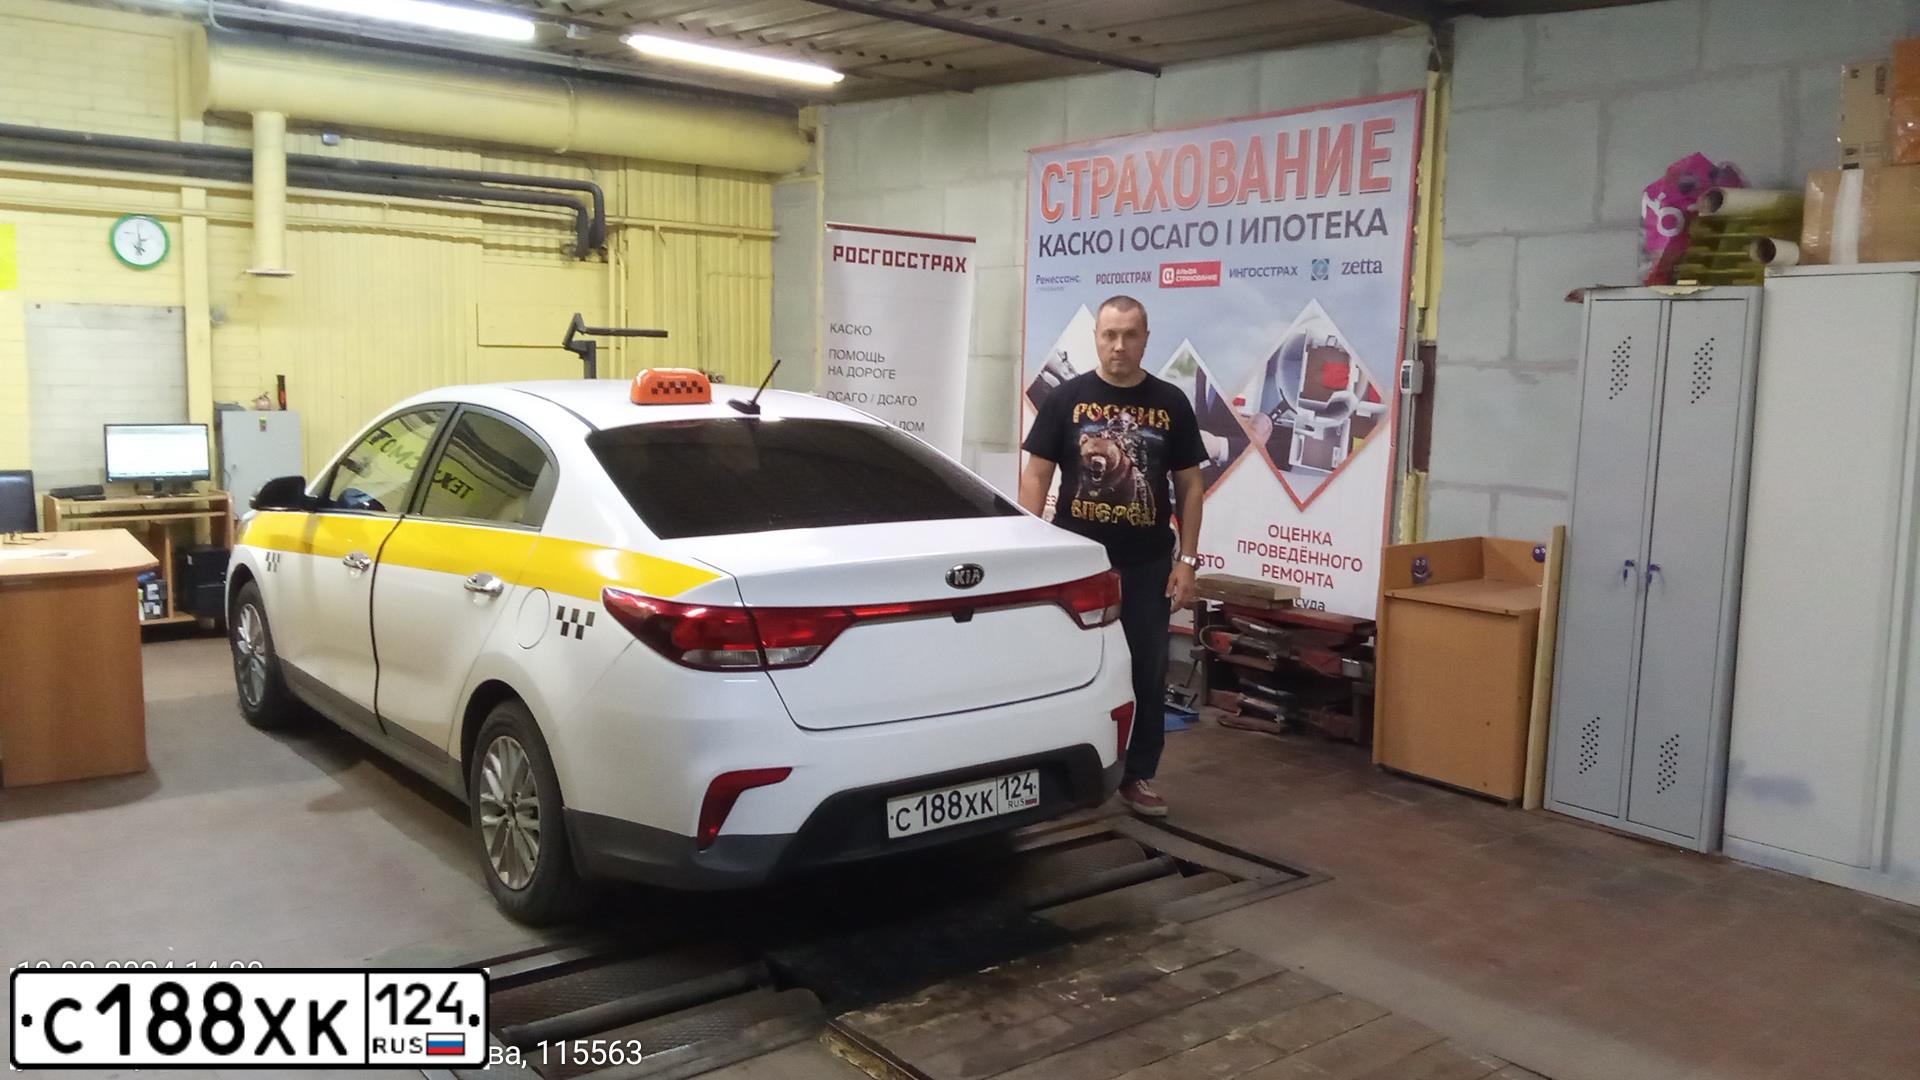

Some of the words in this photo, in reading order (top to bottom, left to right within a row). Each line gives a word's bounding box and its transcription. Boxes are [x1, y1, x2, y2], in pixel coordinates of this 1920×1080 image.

[1040, 117, 1394, 222] СТРАХОВАНИЕ
[1038, 231, 1113, 258] КАСКО
[1130, 221, 1219, 252] ОСАГО
[1240, 208, 1389, 245] ИПОТЕКА
[832, 245, 968, 273] РОСГОССТРАХ
[1341, 258, 1383, 275] zetta
[1095, 271, 1152, 285] РОСГОССТРАХ
[1229, 265, 1298, 279] ИНГОССТРАХ
[829, 322, 872, 336] КАСКО
[829, 348, 885, 363] ПОМОЩЬ
[828, 366, 844, 377] НА
[846, 367, 896, 380] ДОРОГЕ
[826, 391, 868, 403] ОСАГО
[877, 394, 918, 407] ДСАГО
[900, 421, 925, 432] ДОМ
[1267, 524, 1333, 547] ОЦЕНКА
[1197, 553, 1225, 569] ВТО
[1236, 539, 1363, 573] ПРОВЕДЁННОГО
[954, 566, 981, 586] KIA
[1261, 563, 1334, 590] РЕМОНТА
[895, 789, 994, 832] С188ХК
[1000, 772, 1034, 801] 124
[1008, 799, 1025, 809] RUS
